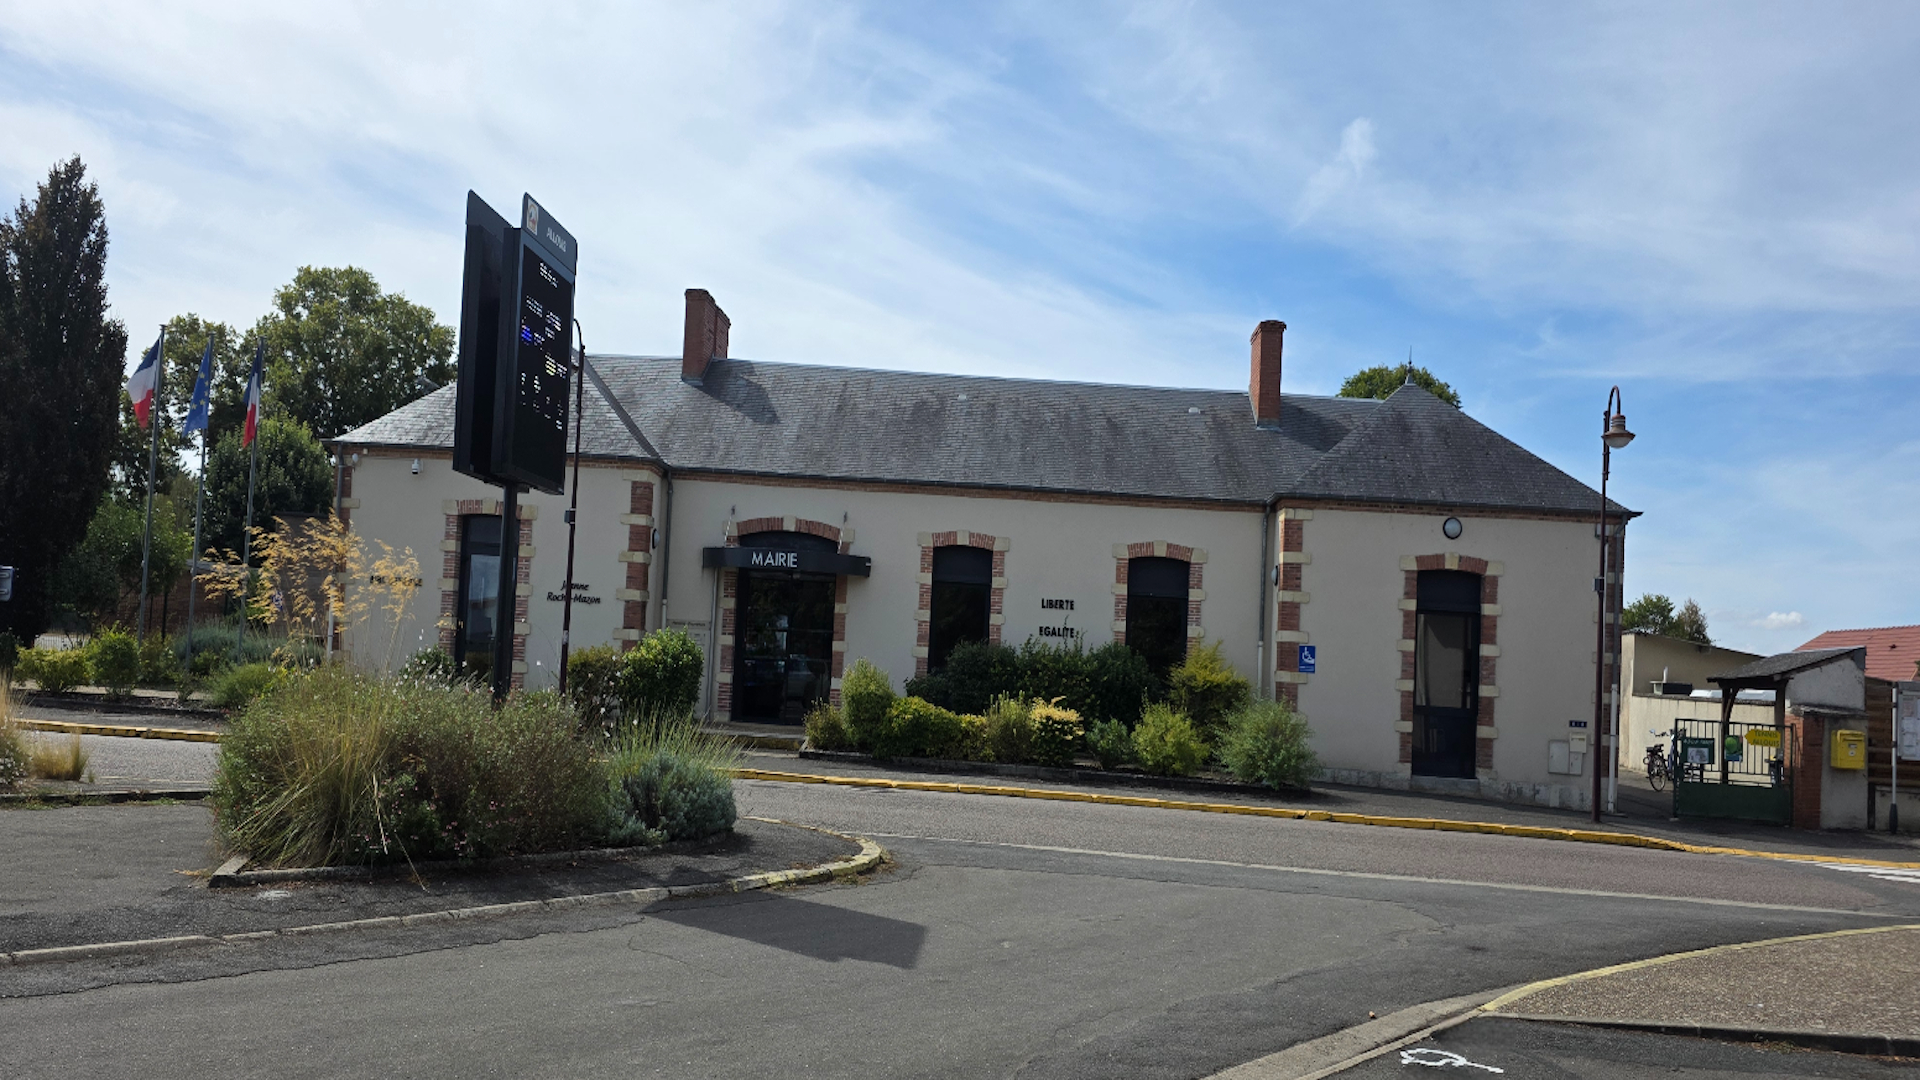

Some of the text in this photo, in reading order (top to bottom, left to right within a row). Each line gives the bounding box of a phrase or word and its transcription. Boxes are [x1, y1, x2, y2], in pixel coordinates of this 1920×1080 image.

[751, 551, 798, 568] MAIRIE
[560, 580, 589, 591] Janne
[1041, 598, 1075, 611] LIBERTE
[1039, 626, 1075, 639] EGALITE
